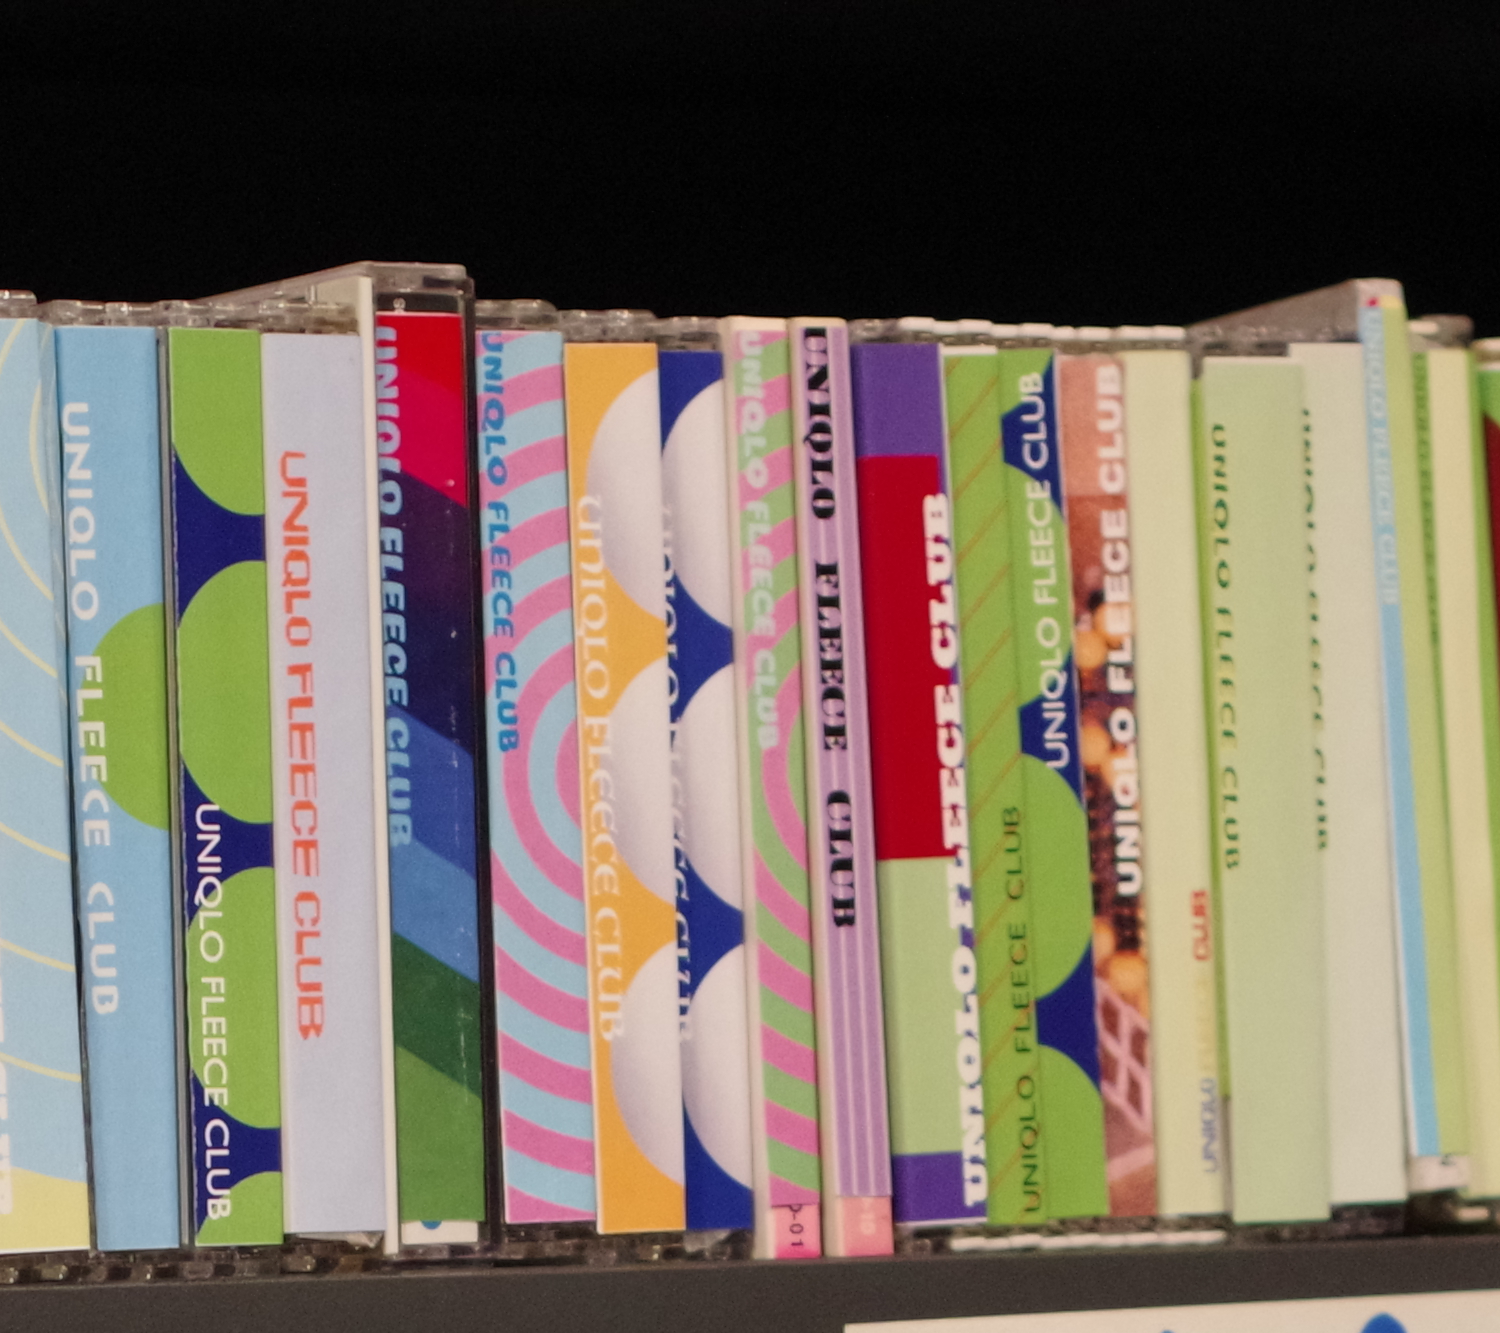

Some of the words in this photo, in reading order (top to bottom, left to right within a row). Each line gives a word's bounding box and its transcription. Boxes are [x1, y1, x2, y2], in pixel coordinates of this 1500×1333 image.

[480, 332, 510, 489] UNIQLO
[803, 326, 836, 520] UNIQLO
[1018, 370, 1050, 471] CLUB
[1094, 362, 1129, 494] CLUB
[61, 402, 100, 623] UNIQLO
[279, 451, 313, 649] UNIQLO
[486, 500, 515, 640] FLEECE
[1025, 478, 1058, 609] FLEECE
[814, 560, 849, 752] FLEECE
[1102, 511, 1137, 689] FLEECE
[73, 655, 112, 848] FLEECE
[286, 662, 320, 878] FLEECE
[494, 651, 520, 753] CLUB
[1034, 618, 1071, 771] UNIQLO
[826, 789, 856, 928] CLUB
[1111, 708, 1143, 897] UNIQLO
[86, 881, 119, 1015] CLUB
[194, 802, 226, 964] UNIQLO
[200, 976, 229, 1107] FLEECE
[292, 891, 326, 1041] CLUB
[204, 1118, 232, 1220] CLUB
